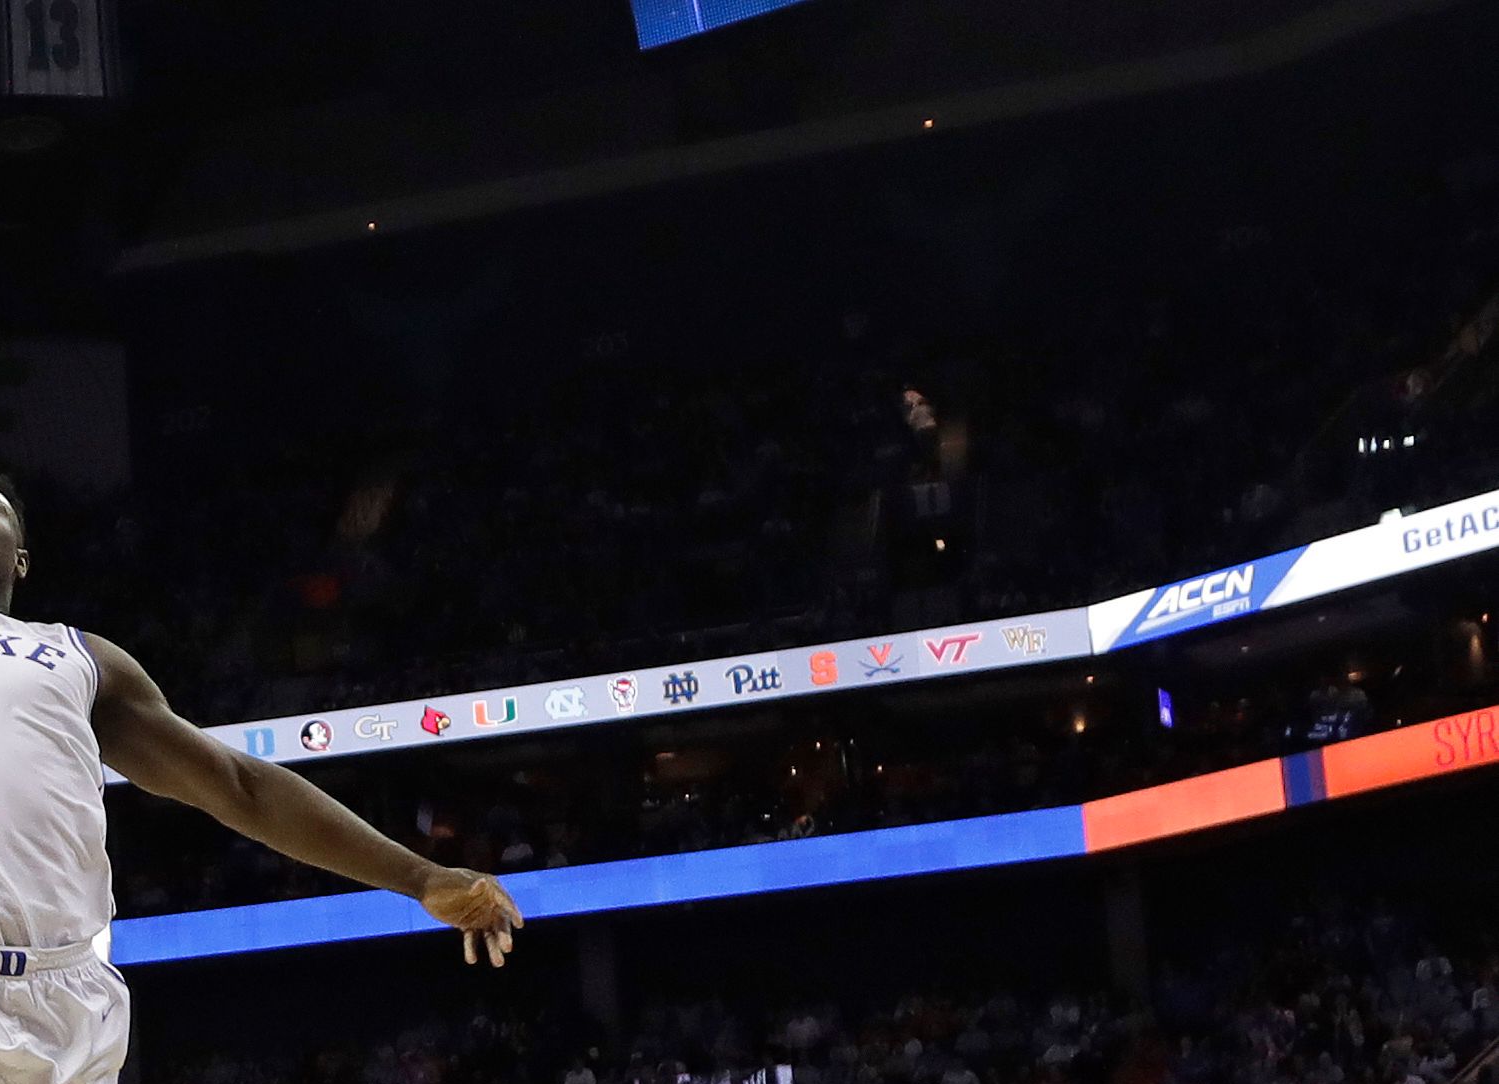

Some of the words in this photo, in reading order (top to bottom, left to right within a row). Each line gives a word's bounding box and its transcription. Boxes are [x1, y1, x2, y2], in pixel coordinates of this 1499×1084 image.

[25, 0, 79, 71] 13
[1147, 564, 1254, 619] ACCN
[923, 632, 981, 665] VT
[725, 663, 781, 695] Pitt
[809, 651, 838, 685] S
